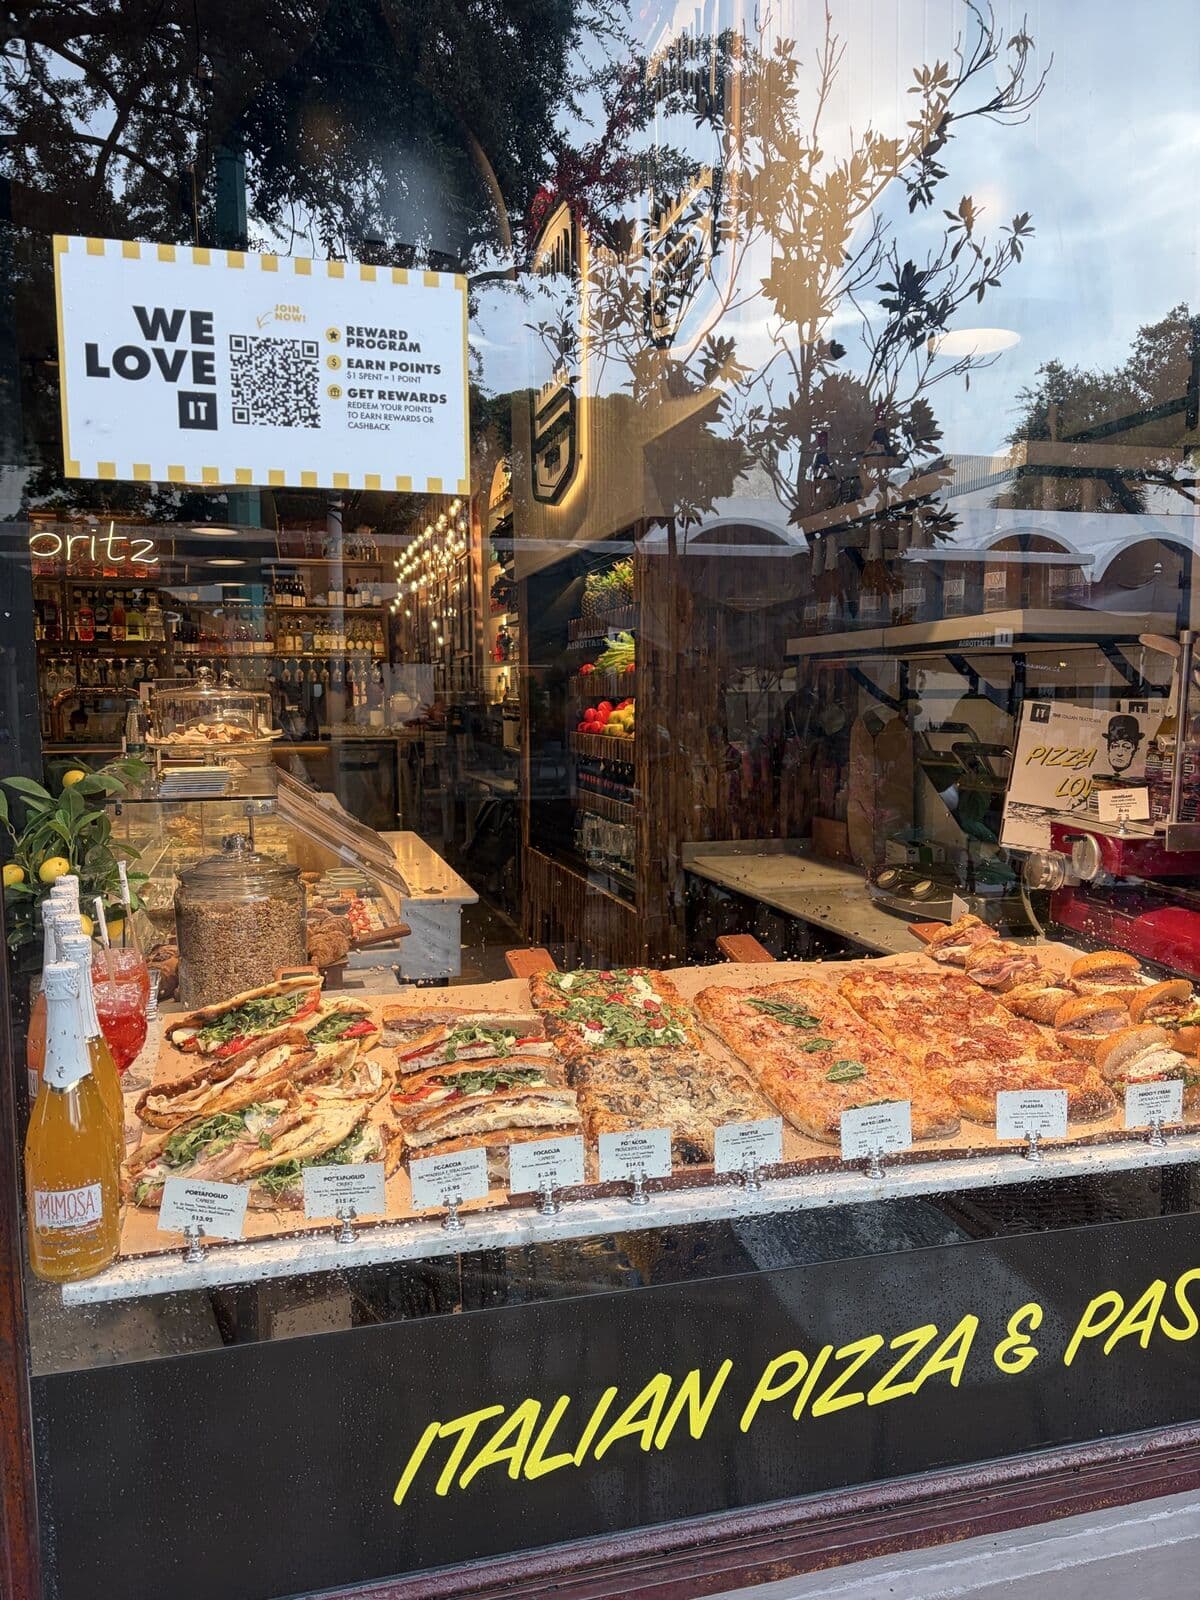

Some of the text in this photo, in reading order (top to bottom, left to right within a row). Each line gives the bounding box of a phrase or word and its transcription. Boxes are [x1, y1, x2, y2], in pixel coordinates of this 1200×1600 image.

[274, 303, 300, 314] JOIN
[132, 305, 215, 345] WE
[275, 312, 307, 323] NOW!
[346, 325, 408, 340] REWARD
[346, 336, 421, 353] PROGRAM
[85, 342, 216, 386] LOVE
[346, 358, 442, 375] EARN POINTS
[358, 372, 383, 381] SPENT
[397, 375, 422, 384] POINT
[347, 388, 447, 404] GET REWARDS
[188, 400, 208, 421] IT
[347, 401, 432, 414] REDEEM YOUR POINTS
[347, 412, 434, 424] TO EARN REWARDS OR
[347, 422, 390, 431] CASHBACK
[1025, 744, 1098, 768] PIZZA
[185, 1189, 229, 1200] PORTAFOGLIO
[39, 1189, 95, 1219] MIMOSA
[393, 1267, 1200, 1506] ITALIAN PIZZA & PAS
